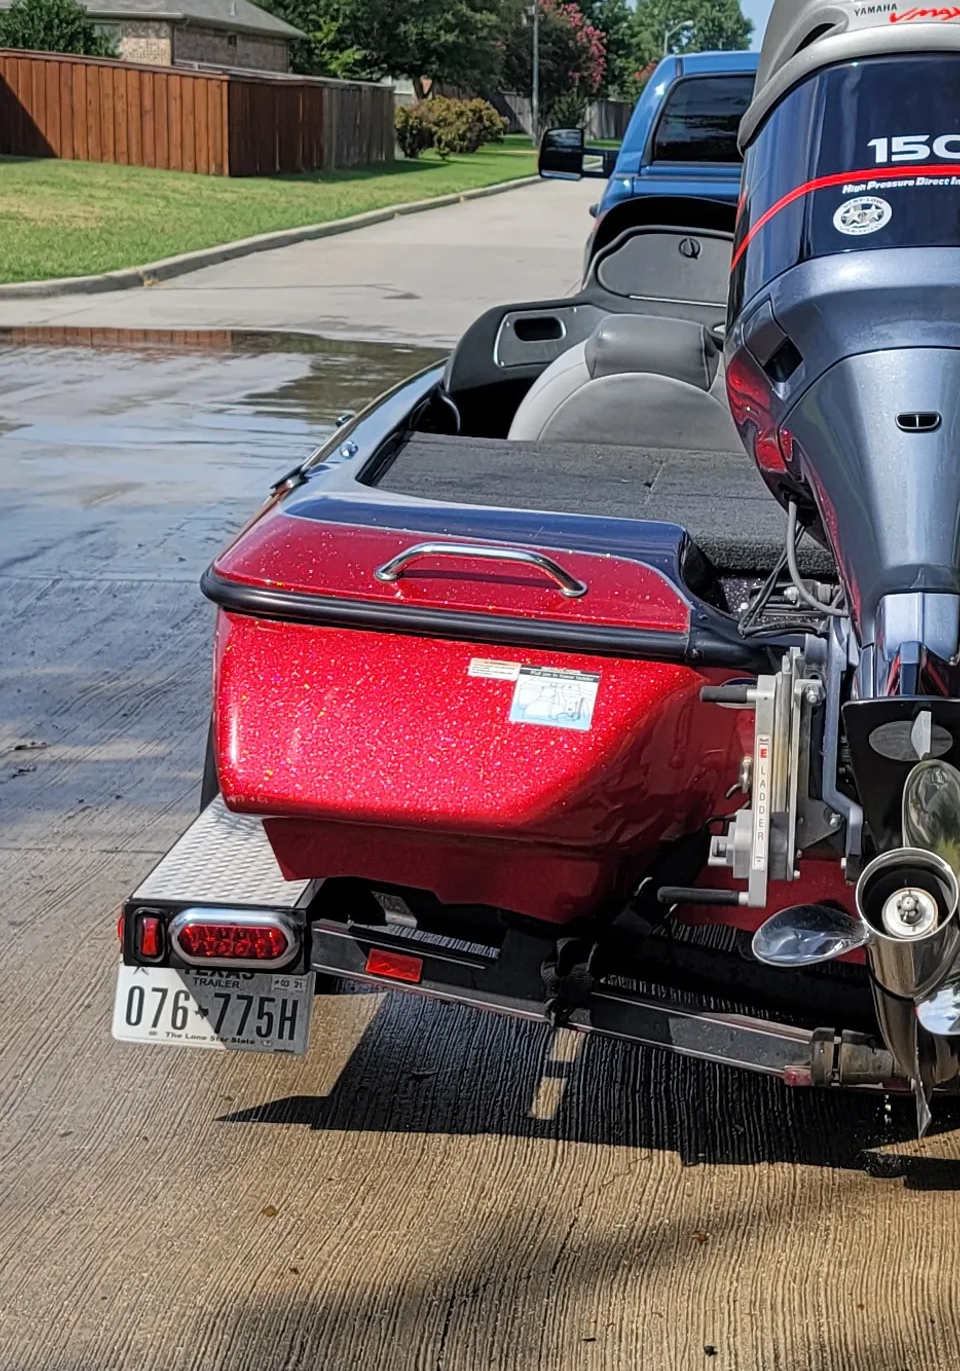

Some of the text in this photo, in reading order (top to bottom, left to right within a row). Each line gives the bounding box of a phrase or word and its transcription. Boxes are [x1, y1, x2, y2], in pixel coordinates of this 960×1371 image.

[854, 3, 898, 17] YAMAHA
[842, 182, 867, 194] High
[867, 180, 915, 190] Pressure
[916, 177, 950, 186] Direct
[757, 765, 767, 841] LADDER
[193, 977, 240, 989] TRAILER
[165, 1031, 183, 1039] The
[185, 1033, 207, 1041] Lone
[230, 1037, 256, 1045] State
